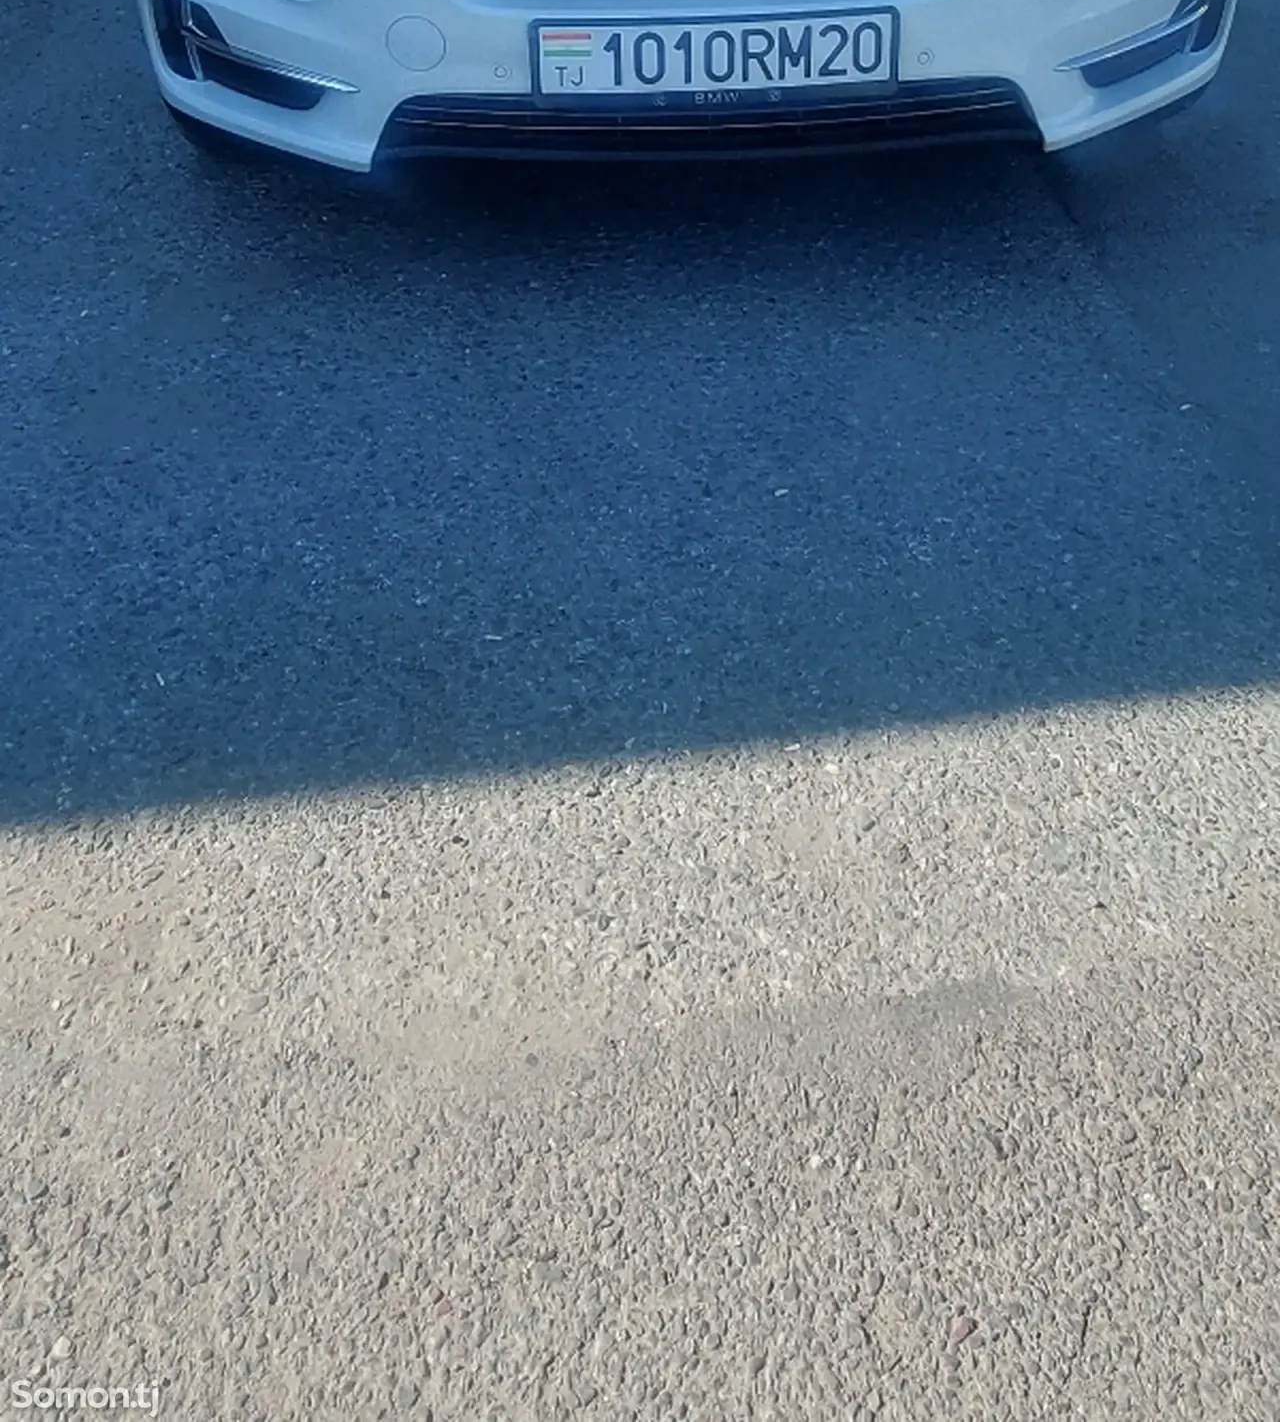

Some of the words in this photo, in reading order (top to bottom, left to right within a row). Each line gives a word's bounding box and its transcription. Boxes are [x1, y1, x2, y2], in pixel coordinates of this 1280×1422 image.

[603, 21, 882, 86] 1010RM20
[554, 66, 584, 87] TJ
[694, 90, 741, 104] BMW
